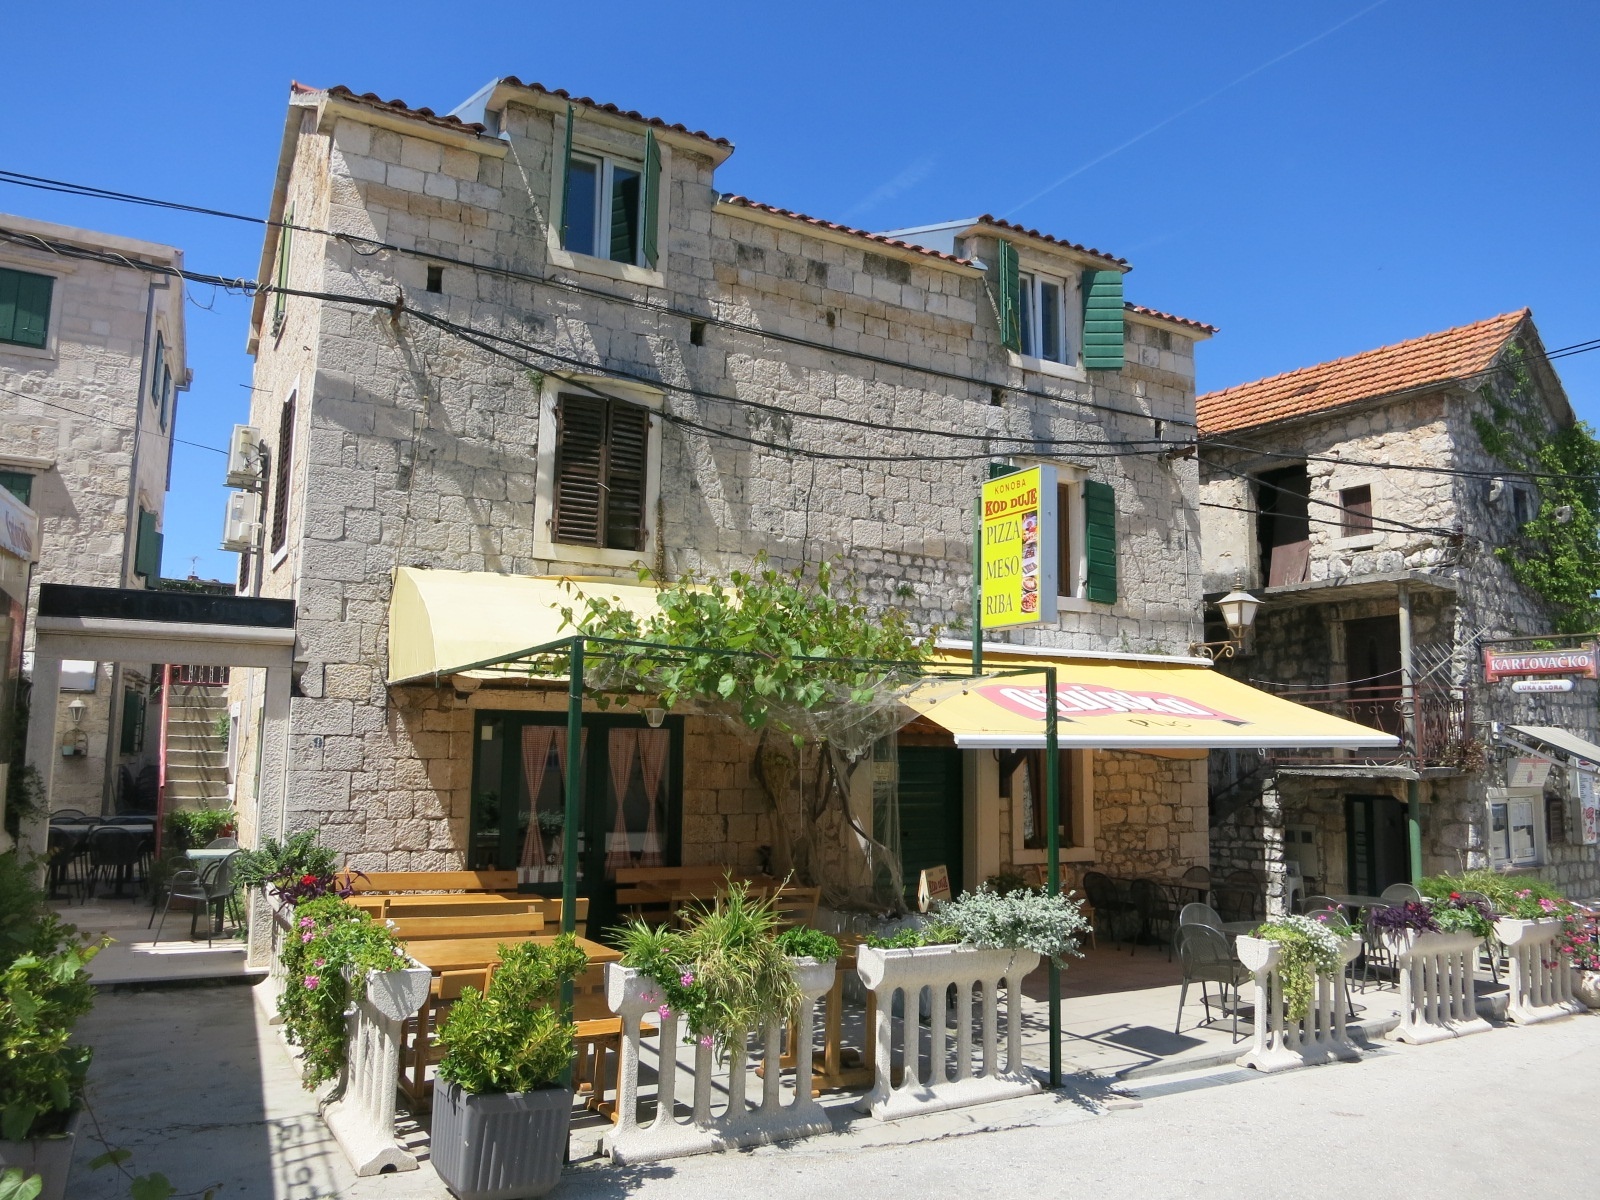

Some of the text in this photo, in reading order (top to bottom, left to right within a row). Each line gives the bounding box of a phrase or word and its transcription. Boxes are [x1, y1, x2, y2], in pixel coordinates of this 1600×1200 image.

[994, 478, 1026, 495] KONOBA
[985, 487, 1037, 517] KOD DUJE
[986, 520, 1020, 545] PIZZA
[986, 555, 1019, 580] MESO
[986, 593, 1013, 615] RIBA
[1491, 653, 1588, 671] KARLOVAČKO
